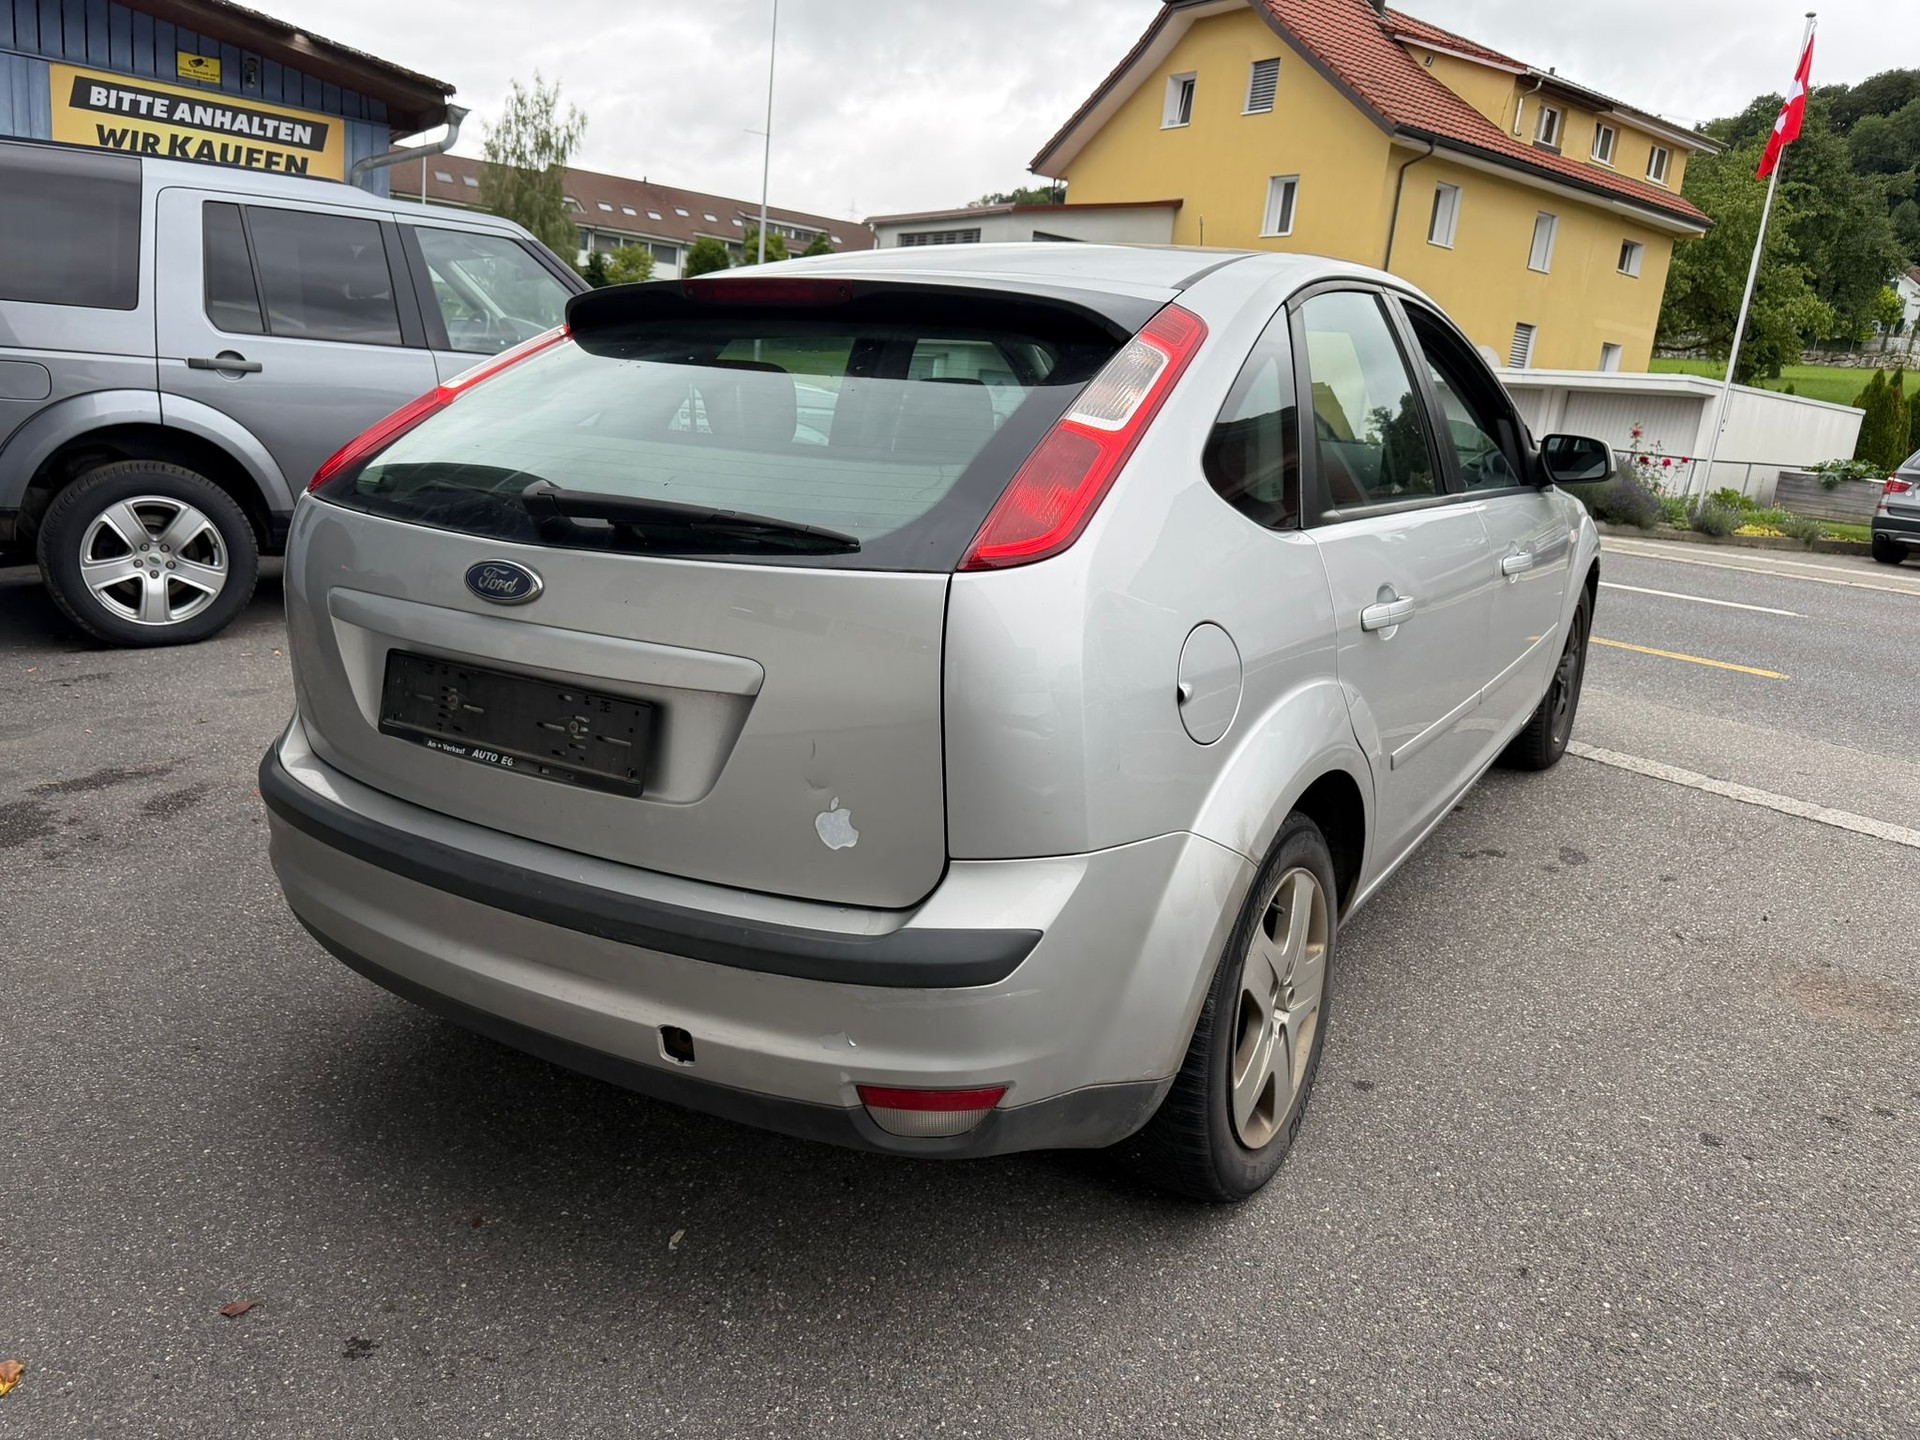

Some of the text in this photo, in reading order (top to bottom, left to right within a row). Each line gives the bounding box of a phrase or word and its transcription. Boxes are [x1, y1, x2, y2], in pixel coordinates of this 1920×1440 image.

[90, 86, 312, 145] BITTE ANHALTEN
[96, 124, 308, 174] WIR KAUFEN
[478, 567, 518, 593] Ford
[427, 740, 437, 748] An
[442, 743, 466, 755] Verkauf
[471, 749, 499, 763] AUTO
